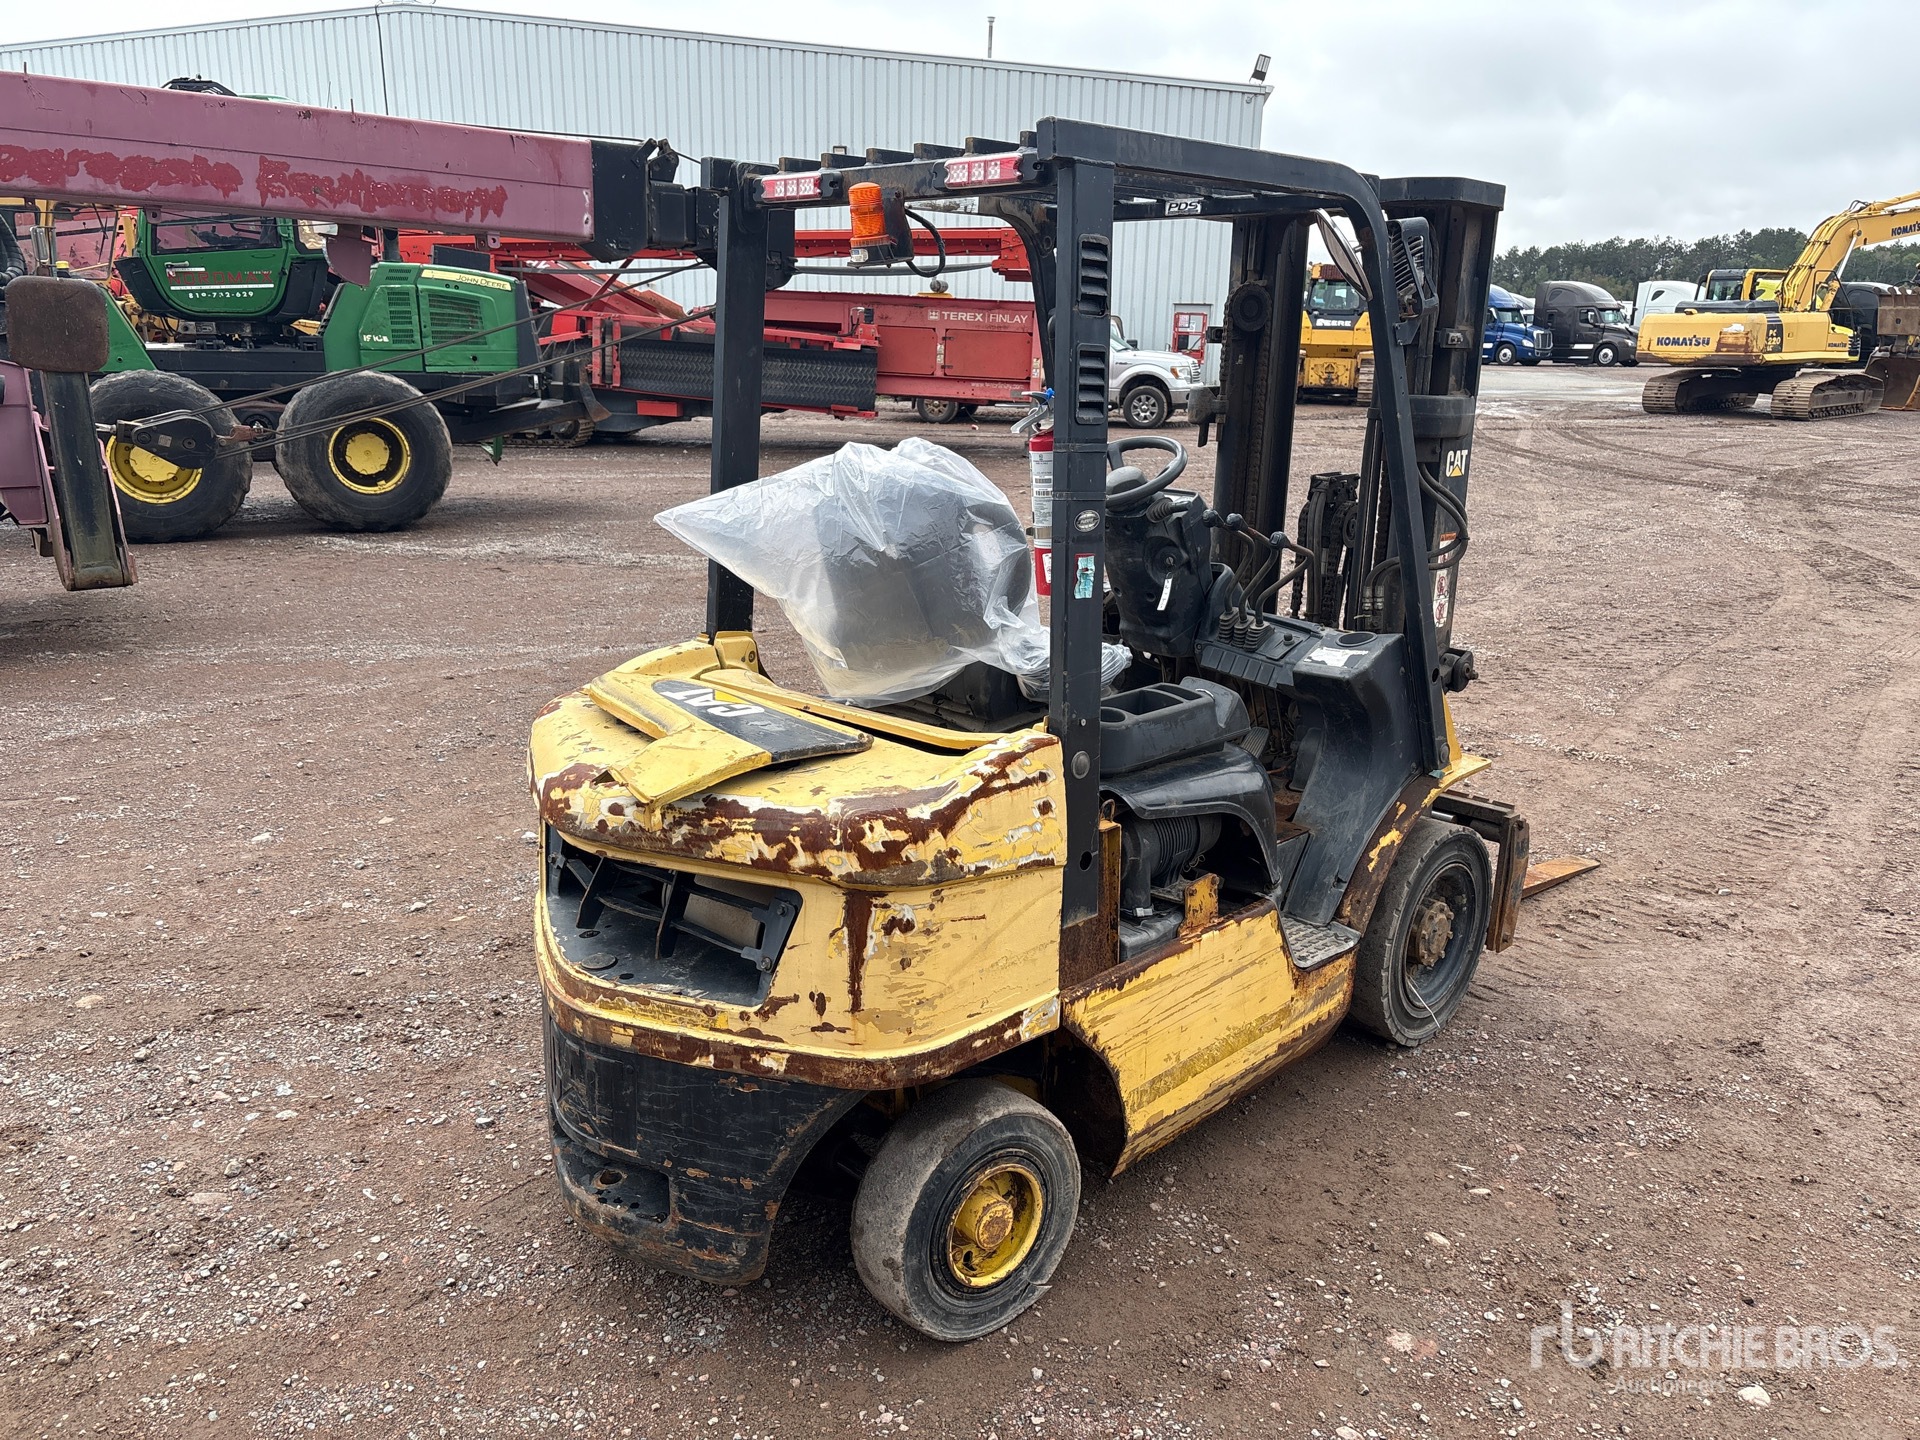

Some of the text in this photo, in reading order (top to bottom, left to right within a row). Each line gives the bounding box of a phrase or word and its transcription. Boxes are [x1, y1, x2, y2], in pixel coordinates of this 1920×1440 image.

[1168, 202, 1198, 211] PDS
[456, 275, 508, 289] JOHN DEERE
[942, 311, 1028, 323] TEREX FINLAY
[1656, 334, 1711, 347] KOMATSU
[1767, 337, 1781, 345] 220
[1446, 450, 1468, 477] CAT
[660, 688, 765, 718] CAT
